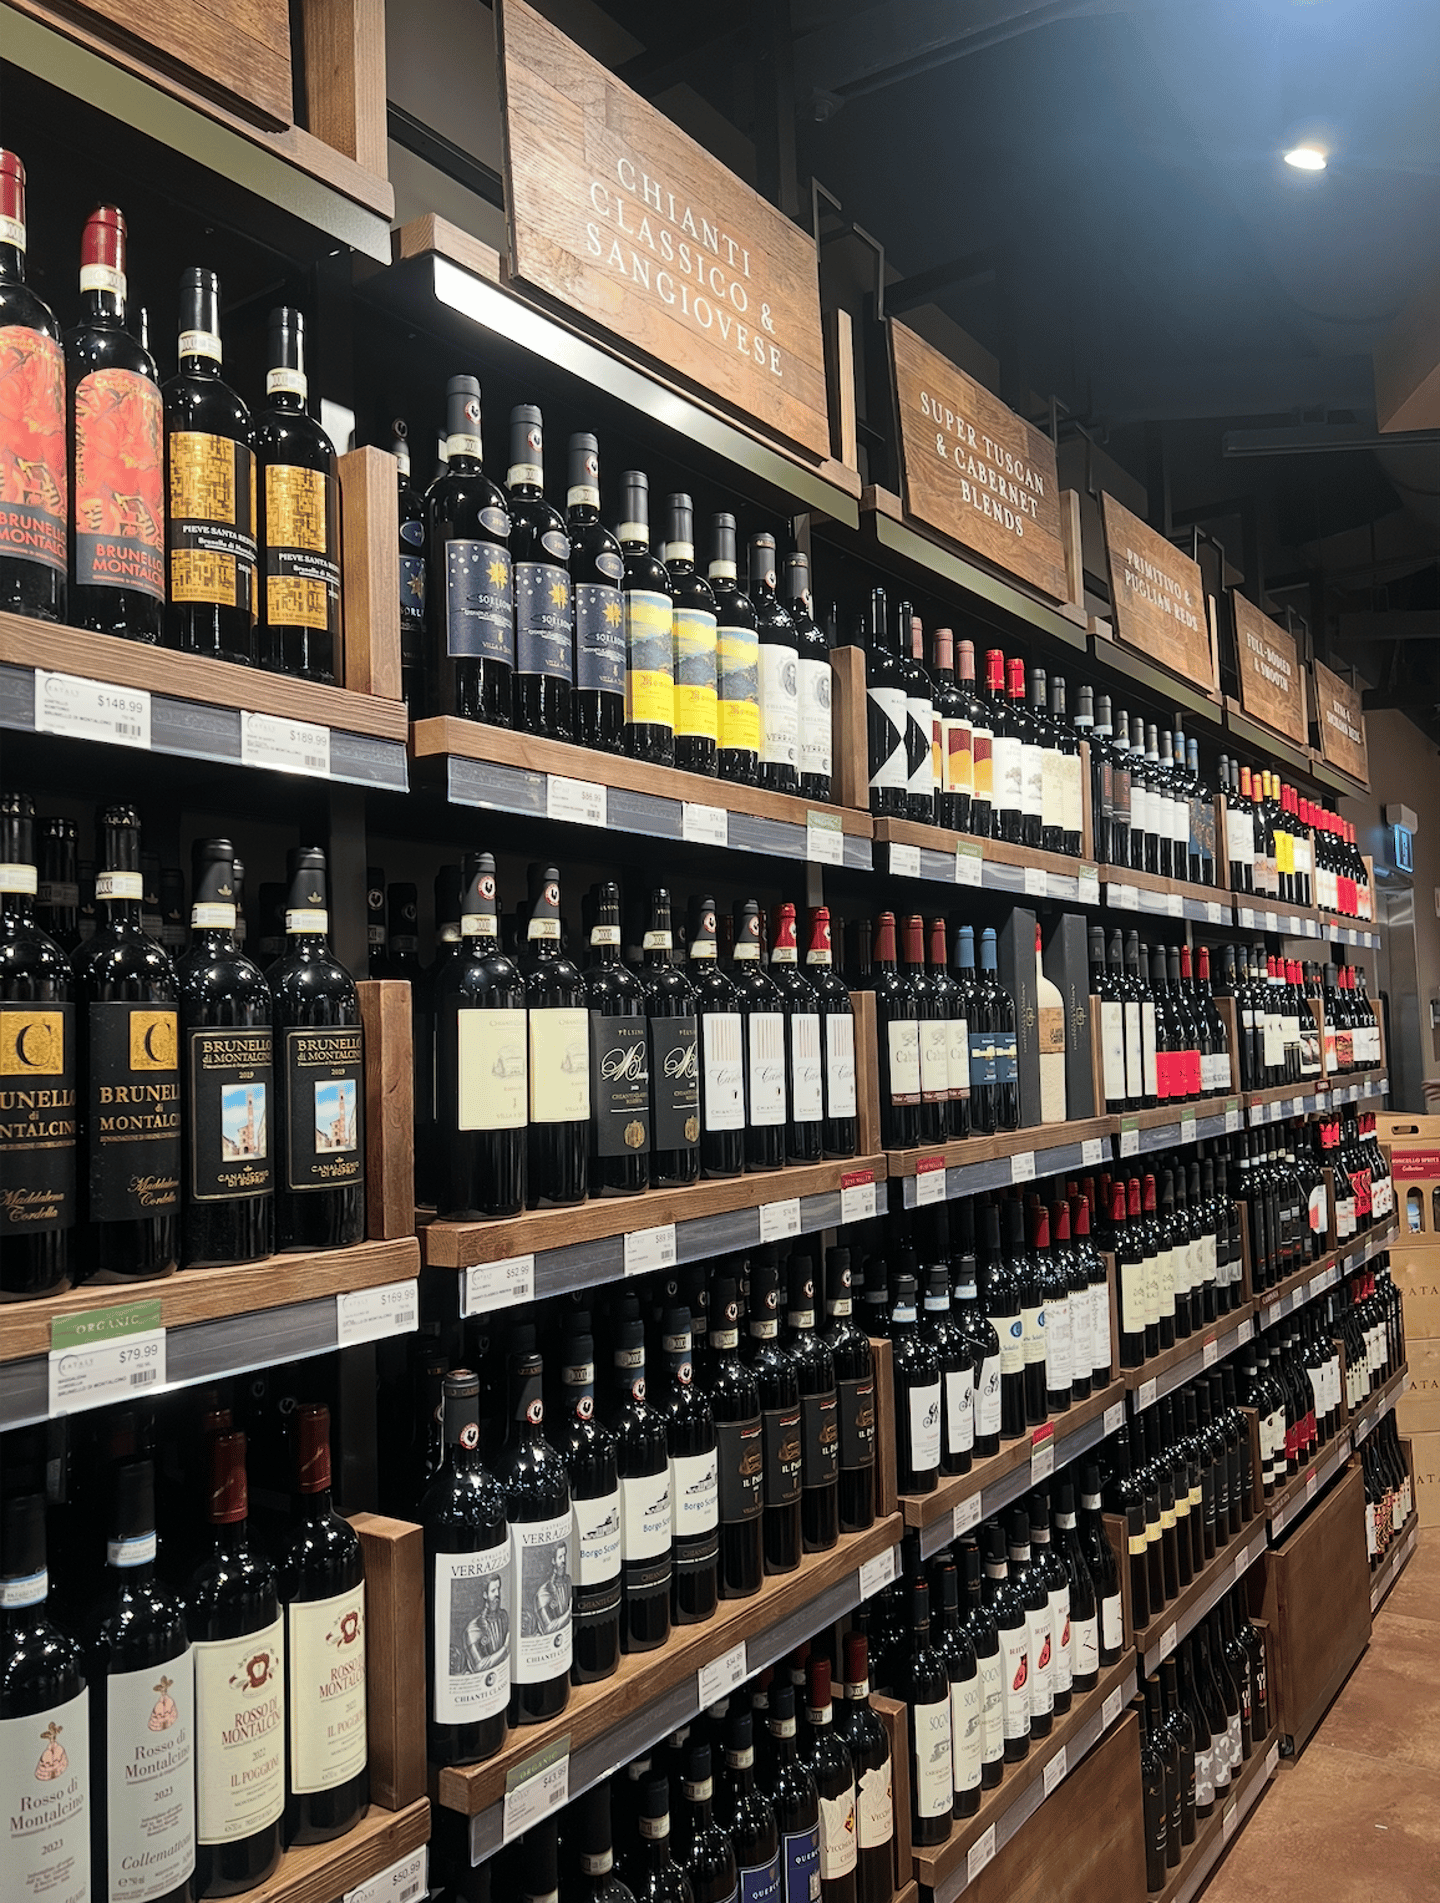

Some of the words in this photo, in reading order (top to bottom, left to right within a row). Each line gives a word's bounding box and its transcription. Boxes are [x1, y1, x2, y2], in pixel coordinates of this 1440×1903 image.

[617, 157, 752, 278] CHIANTI
[590, 181, 748, 312] CLASSICO
[760, 302, 777, 335] &
[586, 222, 783, 377] SANGIOVESE
[919, 390, 979, 452] SUPER
[981, 435, 1045, 497] TUSCAN
[935, 433, 948, 459] &
[954, 446, 1039, 519] CABERNET
[960, 479, 1024, 538] BLENDS
[95, 542, 163, 573] BRUNELLO
[1126, 547, 1182, 601] PRIMITIVO
[1124, 568, 1172, 616] PUGLIAN
[1173, 606, 1198, 632] REDS
[97, 694, 143, 713] $148.99
[290, 730, 327, 747] $189.99
[202, 1039, 272, 1053] BRUNELLO
[297, 1038, 362, 1052] BRUNELLO
[506, 1265, 530, 1279] $52.99
[381, 1288, 415, 1305] $169.99
[76, 1314, 139, 1334] ORGANIC
[119, 1344, 158, 1363] $79.99
[684, 1500, 704, 1511] Borgo
[643, 1521, 661, 1533] Borgo
[580, 1547, 603, 1559] Borgo
[526, 1653, 556, 1664] CHIANTI
[454, 1691, 488, 1703] CHIANTI
[234, 1703, 269, 1728] ROSSO
[134, 1740, 174, 1761] Rosso
[177, 1727, 186, 1745] di
[125, 1745, 190, 1779] Montalcino
[519, 1751, 558, 1780] ORGANIC
[231, 1774, 241, 1787] IL
[20, 1789, 64, 1812] Rosso
[67, 1776, 79, 1795] di
[154, 1785, 173, 1801] 2023
[10, 1793, 84, 1832] Montalcino
[41, 1838, 64, 1855] 2023
[392, 1860, 421, 1886] $50.99
